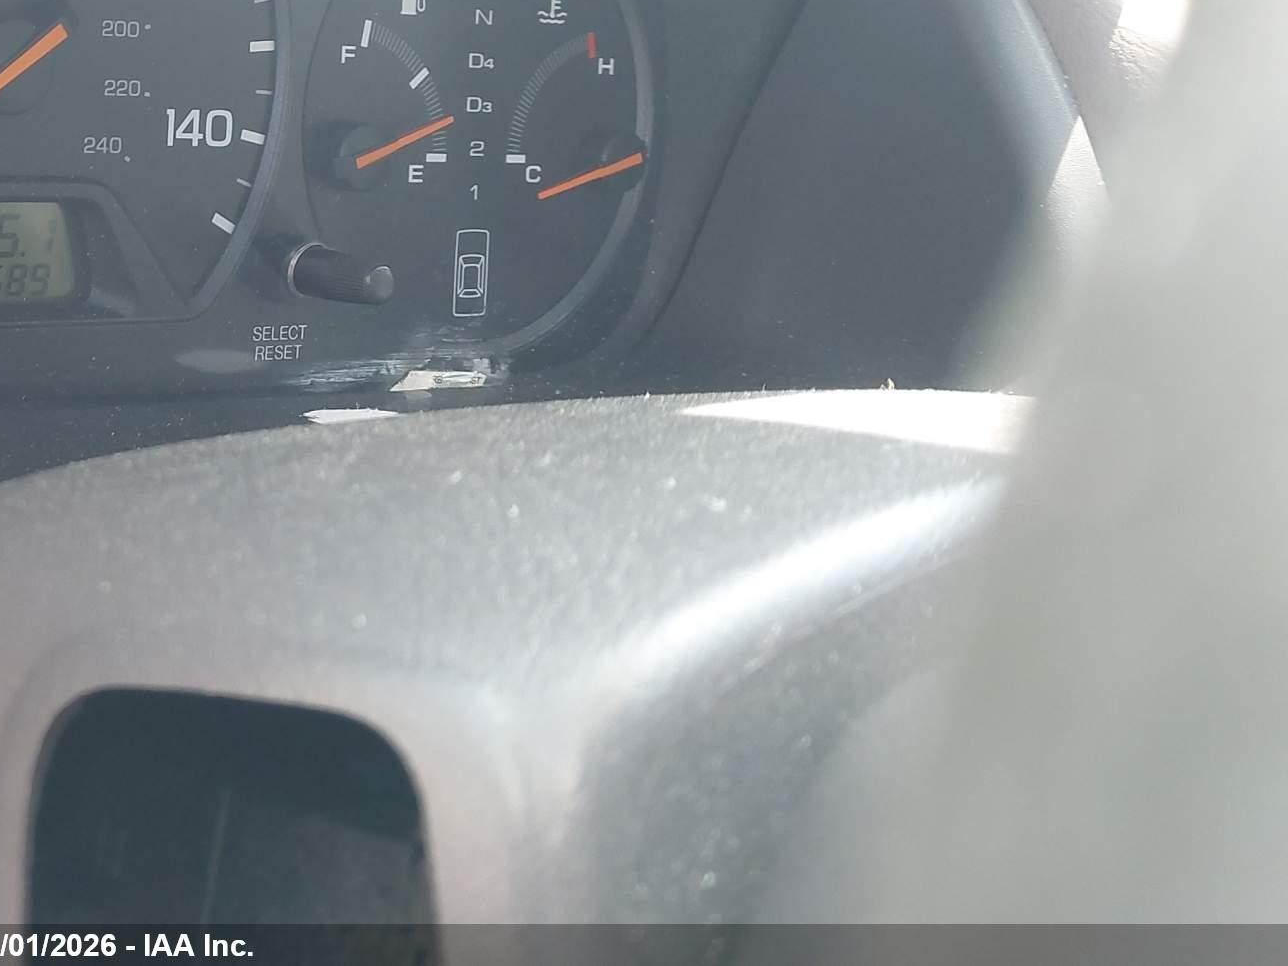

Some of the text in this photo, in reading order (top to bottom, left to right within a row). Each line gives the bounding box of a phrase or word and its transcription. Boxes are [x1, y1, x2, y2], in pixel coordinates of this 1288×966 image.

[475, 9, 493, 26] N
[101, 20, 140, 38] 200
[341, 45, 357, 64] F
[468, 52, 495, 70] D4
[598, 57, 615, 76] H
[104, 79, 141, 97] 220
[466, 96, 492, 113] D3
[166, 108, 233, 147] 140
[83, 136, 122, 154] 240
[469, 140, 485, 157] 2
[408, 164, 424, 183] E
[525, 165, 542, 183] C
[469, 184, 478, 201] 1
[252, 324, 308, 342] SELECT
[254, 344, 303, 362] RESET
